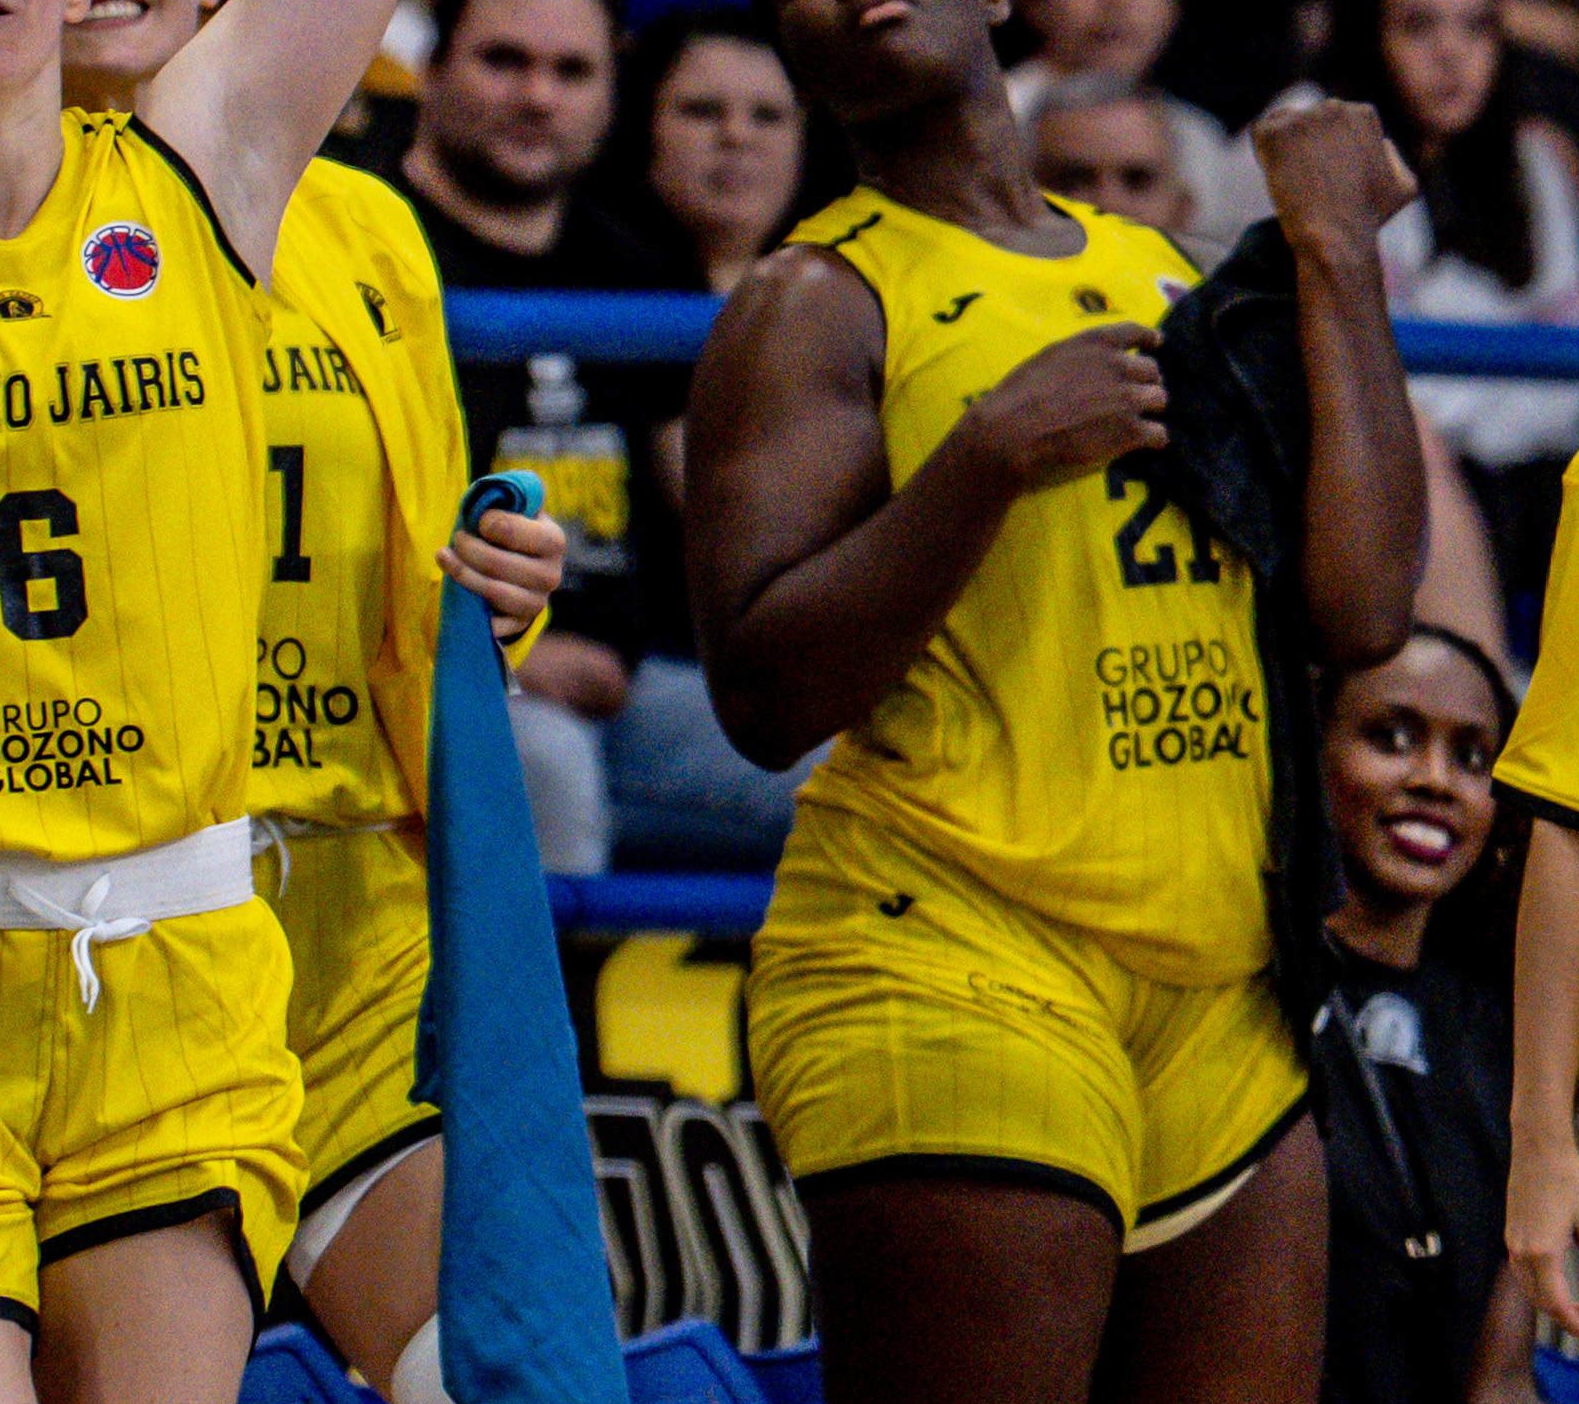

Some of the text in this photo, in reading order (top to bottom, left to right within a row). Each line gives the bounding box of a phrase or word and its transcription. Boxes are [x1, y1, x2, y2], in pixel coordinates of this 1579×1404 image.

[48, 347, 207, 426] JAIRIS
[1106, 459, 1220, 589] 21
[1095, 638, 1228, 688] GRUPO
[1108, 723, 1249, 771] GLOBAL
